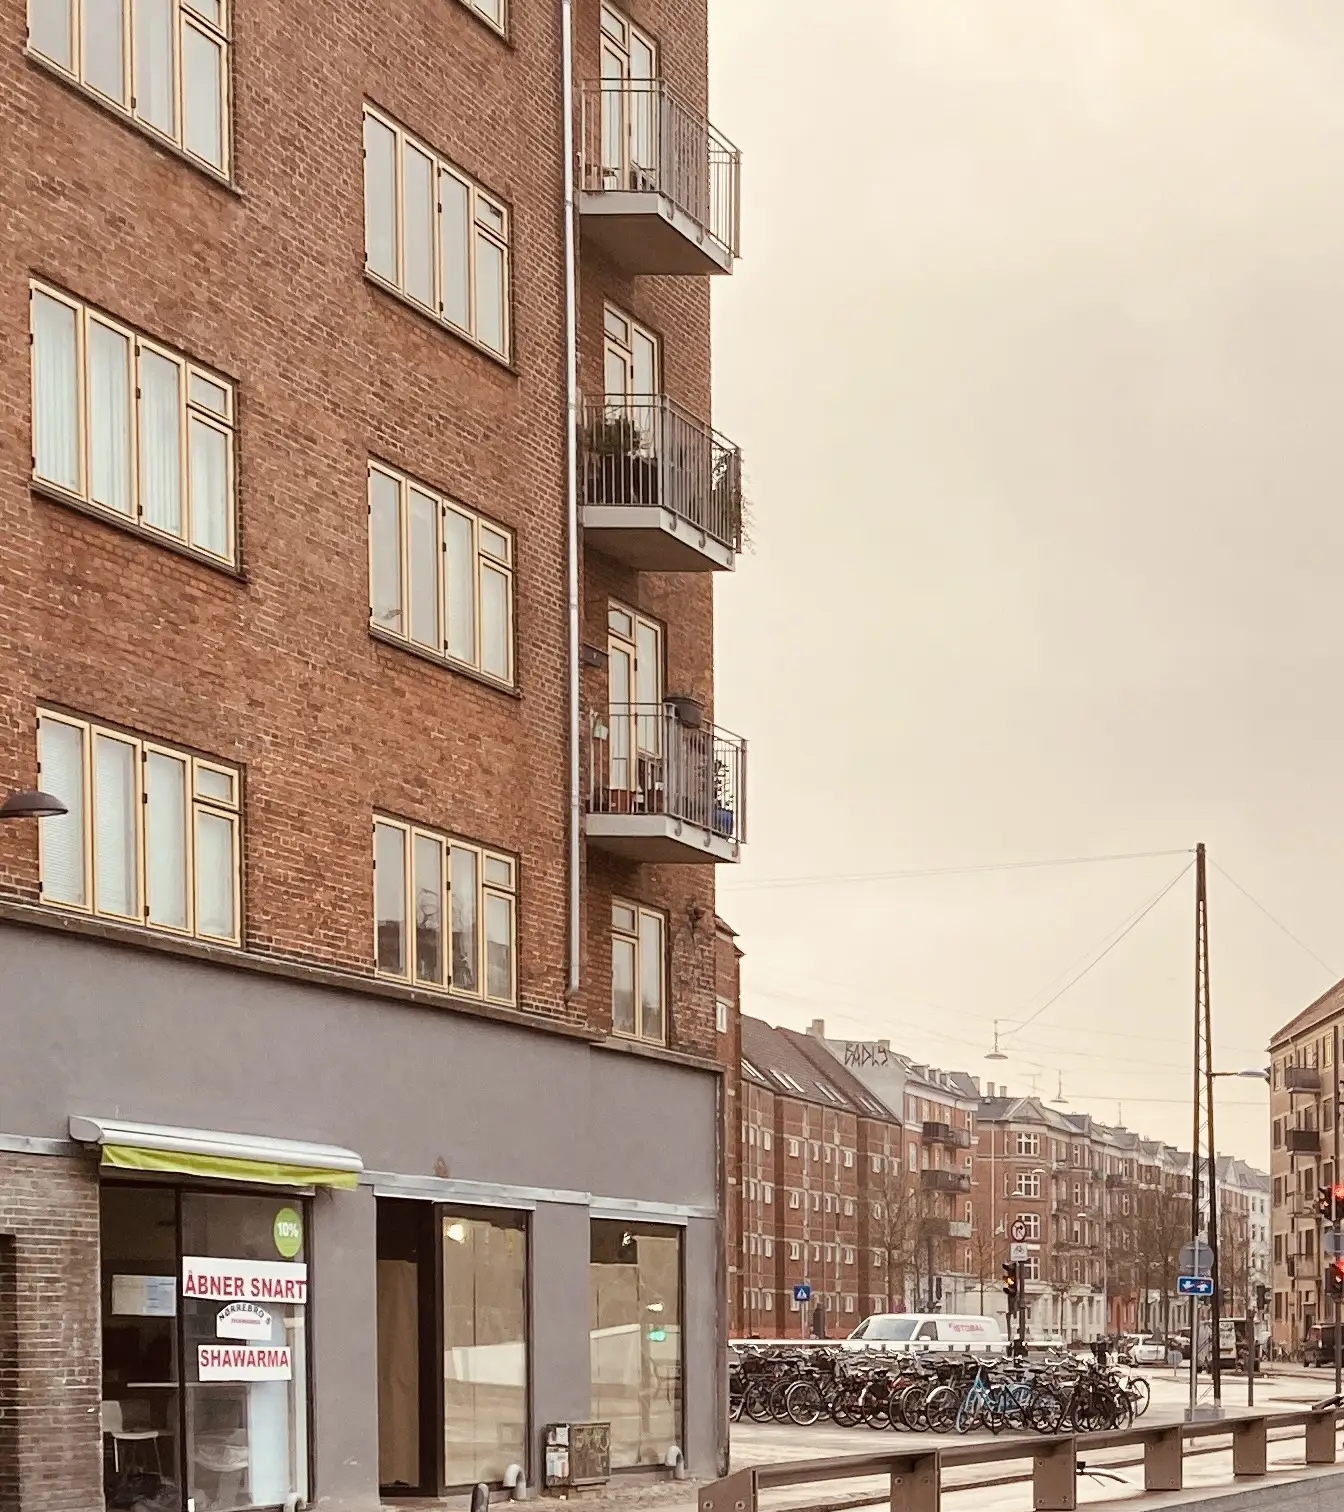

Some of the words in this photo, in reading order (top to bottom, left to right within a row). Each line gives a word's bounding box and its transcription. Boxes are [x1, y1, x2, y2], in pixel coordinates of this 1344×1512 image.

[277, 1221, 299, 1238] 10%
[185, 1270, 245, 1297] ÅBNER
[251, 1279, 307, 1299] SNART
[200, 1350, 289, 1367] SHAWARMA
